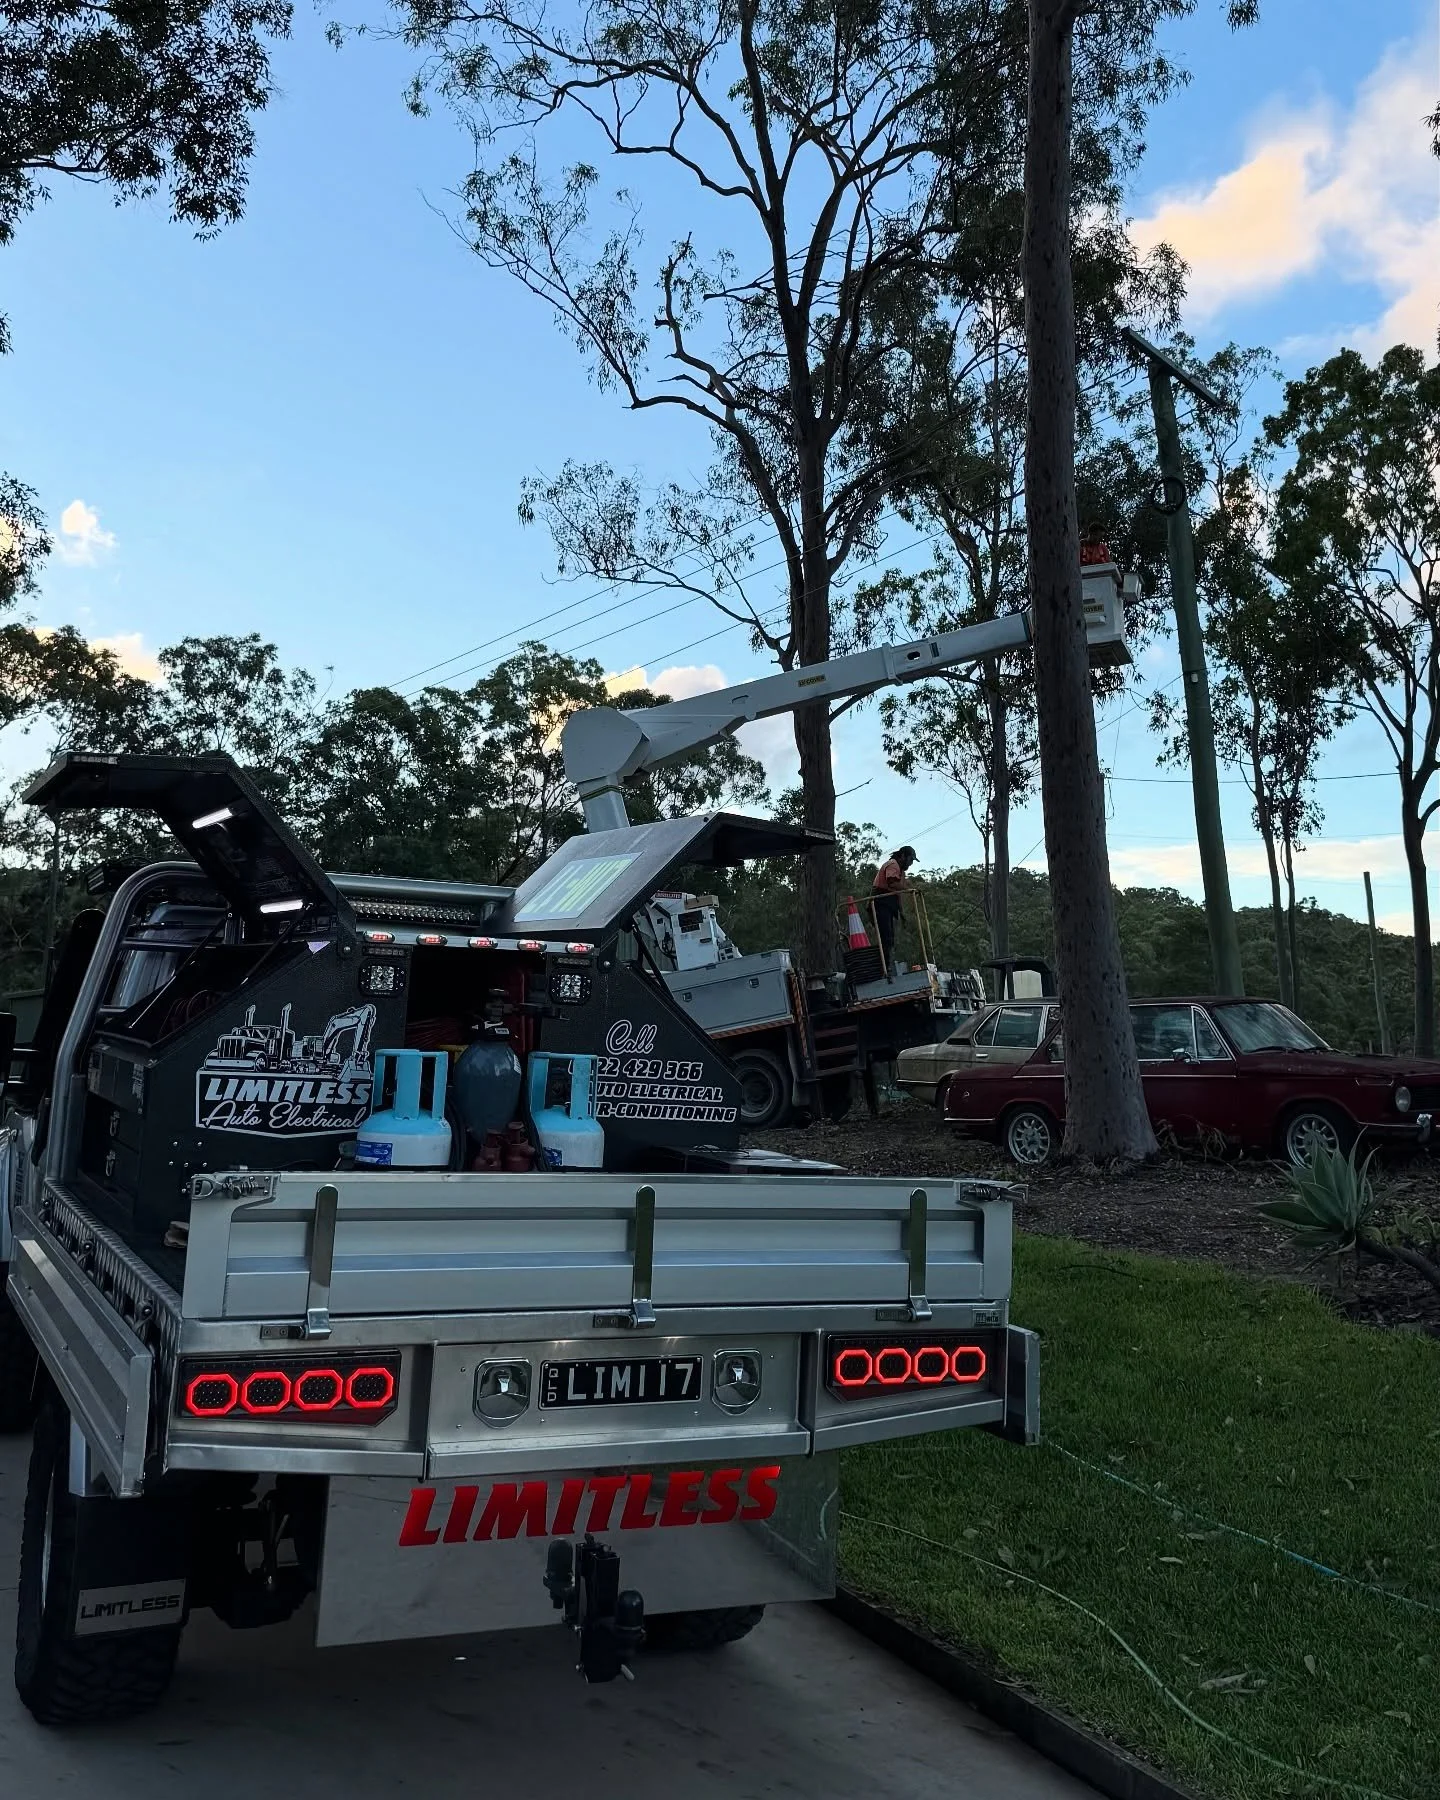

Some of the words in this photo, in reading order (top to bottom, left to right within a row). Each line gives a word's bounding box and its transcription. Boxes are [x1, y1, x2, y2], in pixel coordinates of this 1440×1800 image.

[606, 1020, 657, 1055] Call
[623, 1059, 662, 1079] 429
[663, 1061, 703, 1081] 366
[204, 1078, 371, 1104] LIMITLESS
[628, 1084, 723, 1102] ELECTRICAL
[202, 1101, 262, 1127] Auto
[268, 1101, 367, 1129] Electrical
[399, 1465, 782, 1546] LIMITLESS
[81, 1594, 181, 1619] LIMITLESS
